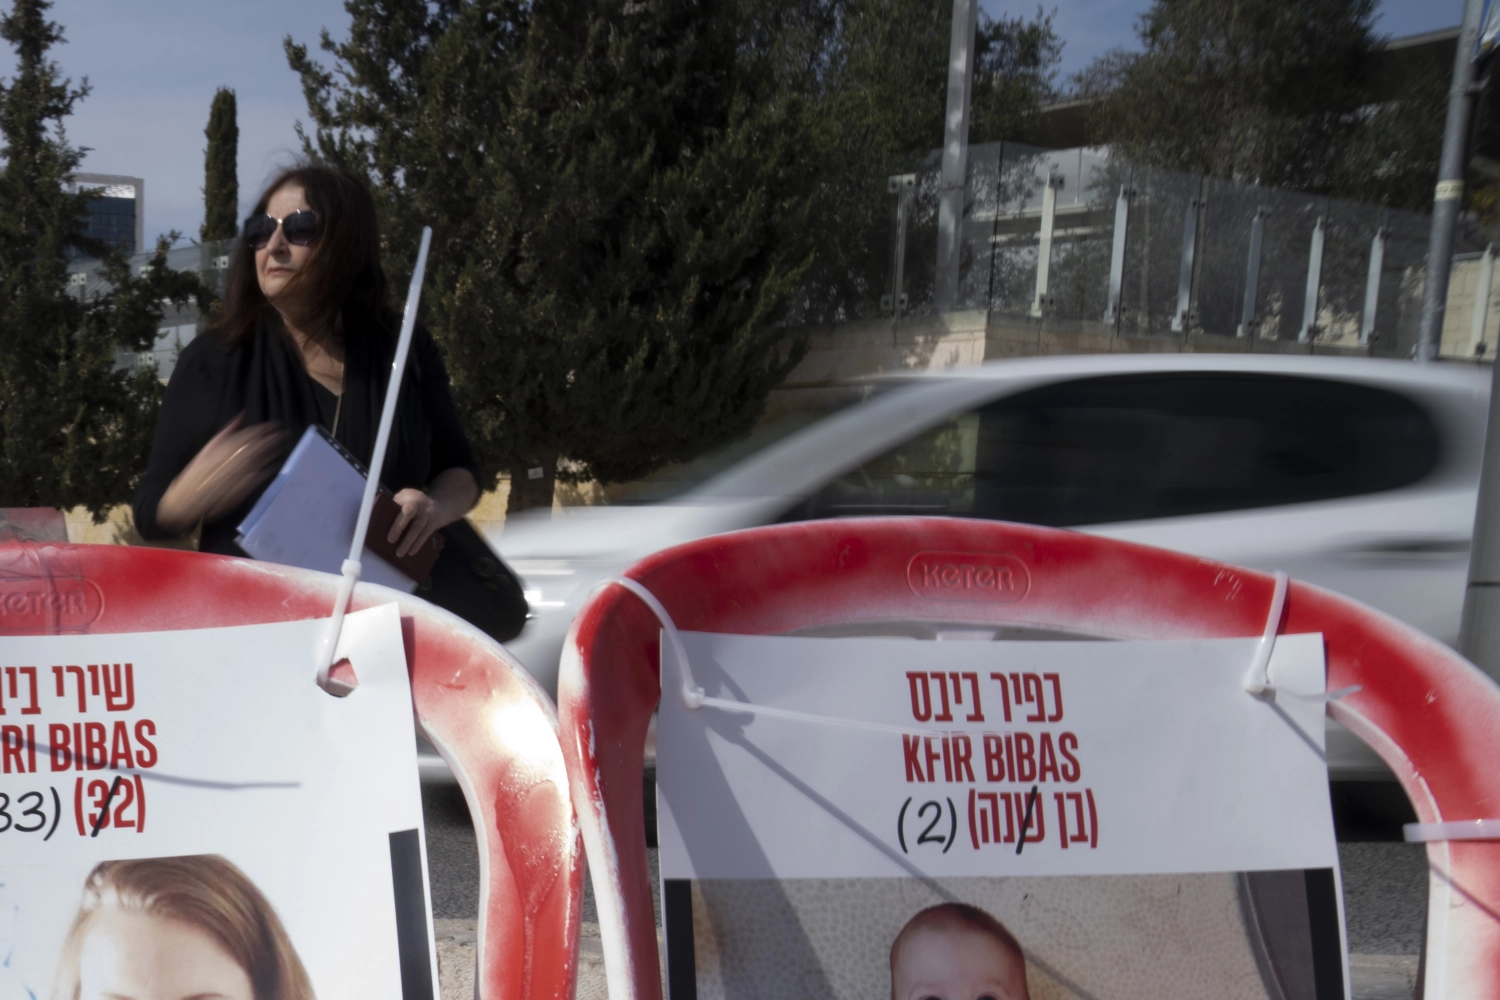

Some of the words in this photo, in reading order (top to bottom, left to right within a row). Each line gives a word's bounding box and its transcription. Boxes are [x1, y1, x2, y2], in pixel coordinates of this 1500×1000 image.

[52, 663, 135, 713] שירי
[905, 671, 985, 722] ביבס
[990, 672, 1064, 723] כפיר
[49, 719, 158, 772] BIBAS
[902, 731, 976, 783] KFIR
[982, 730, 1081, 783] BIBAS
[897, 796, 957, 854] (2)
